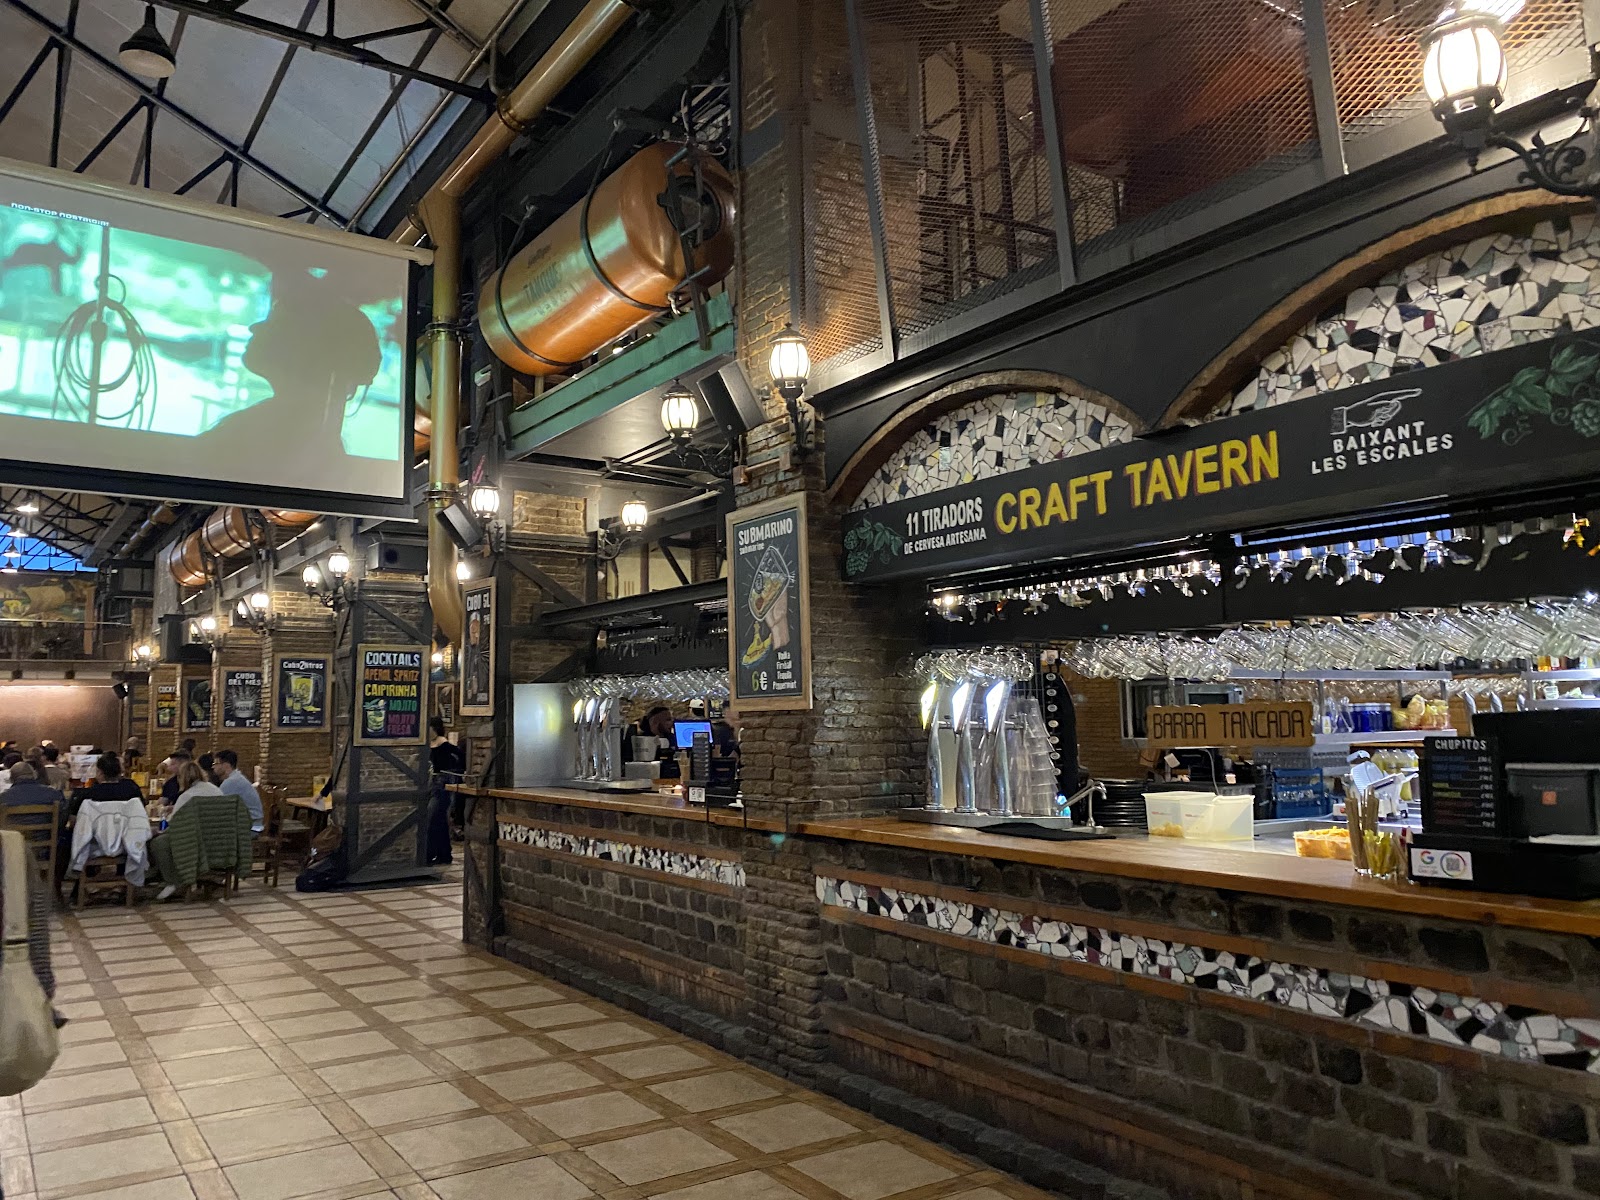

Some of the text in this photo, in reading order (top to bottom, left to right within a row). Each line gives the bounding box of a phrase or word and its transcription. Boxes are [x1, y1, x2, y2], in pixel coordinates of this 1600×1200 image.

[1333, 421, 1425, 454] BAIXANT
[1311, 433, 1454, 475] LES ESCALES
[994, 430, 1280, 534] CRAFT TAVERN
[904, 496, 983, 537] 11 TIRADORS
[738, 517, 793, 546] SUBMARINO
[903, 526, 987, 555] DE CERVESA ARTESANA
[366, 652, 420, 666] COCKTAILS
[364, 668, 420, 681] APEROL SPRITZ
[365, 683, 417, 697] CAIPIRINHA
[389, 699, 417, 711] MOJITO
[387, 724, 412, 735] FRESA
[388, 713, 416, 725] MOJITO
[1153, 710, 1305, 739] BARRA TANCADA
[1434, 739, 1487, 751] CHUPITOS
